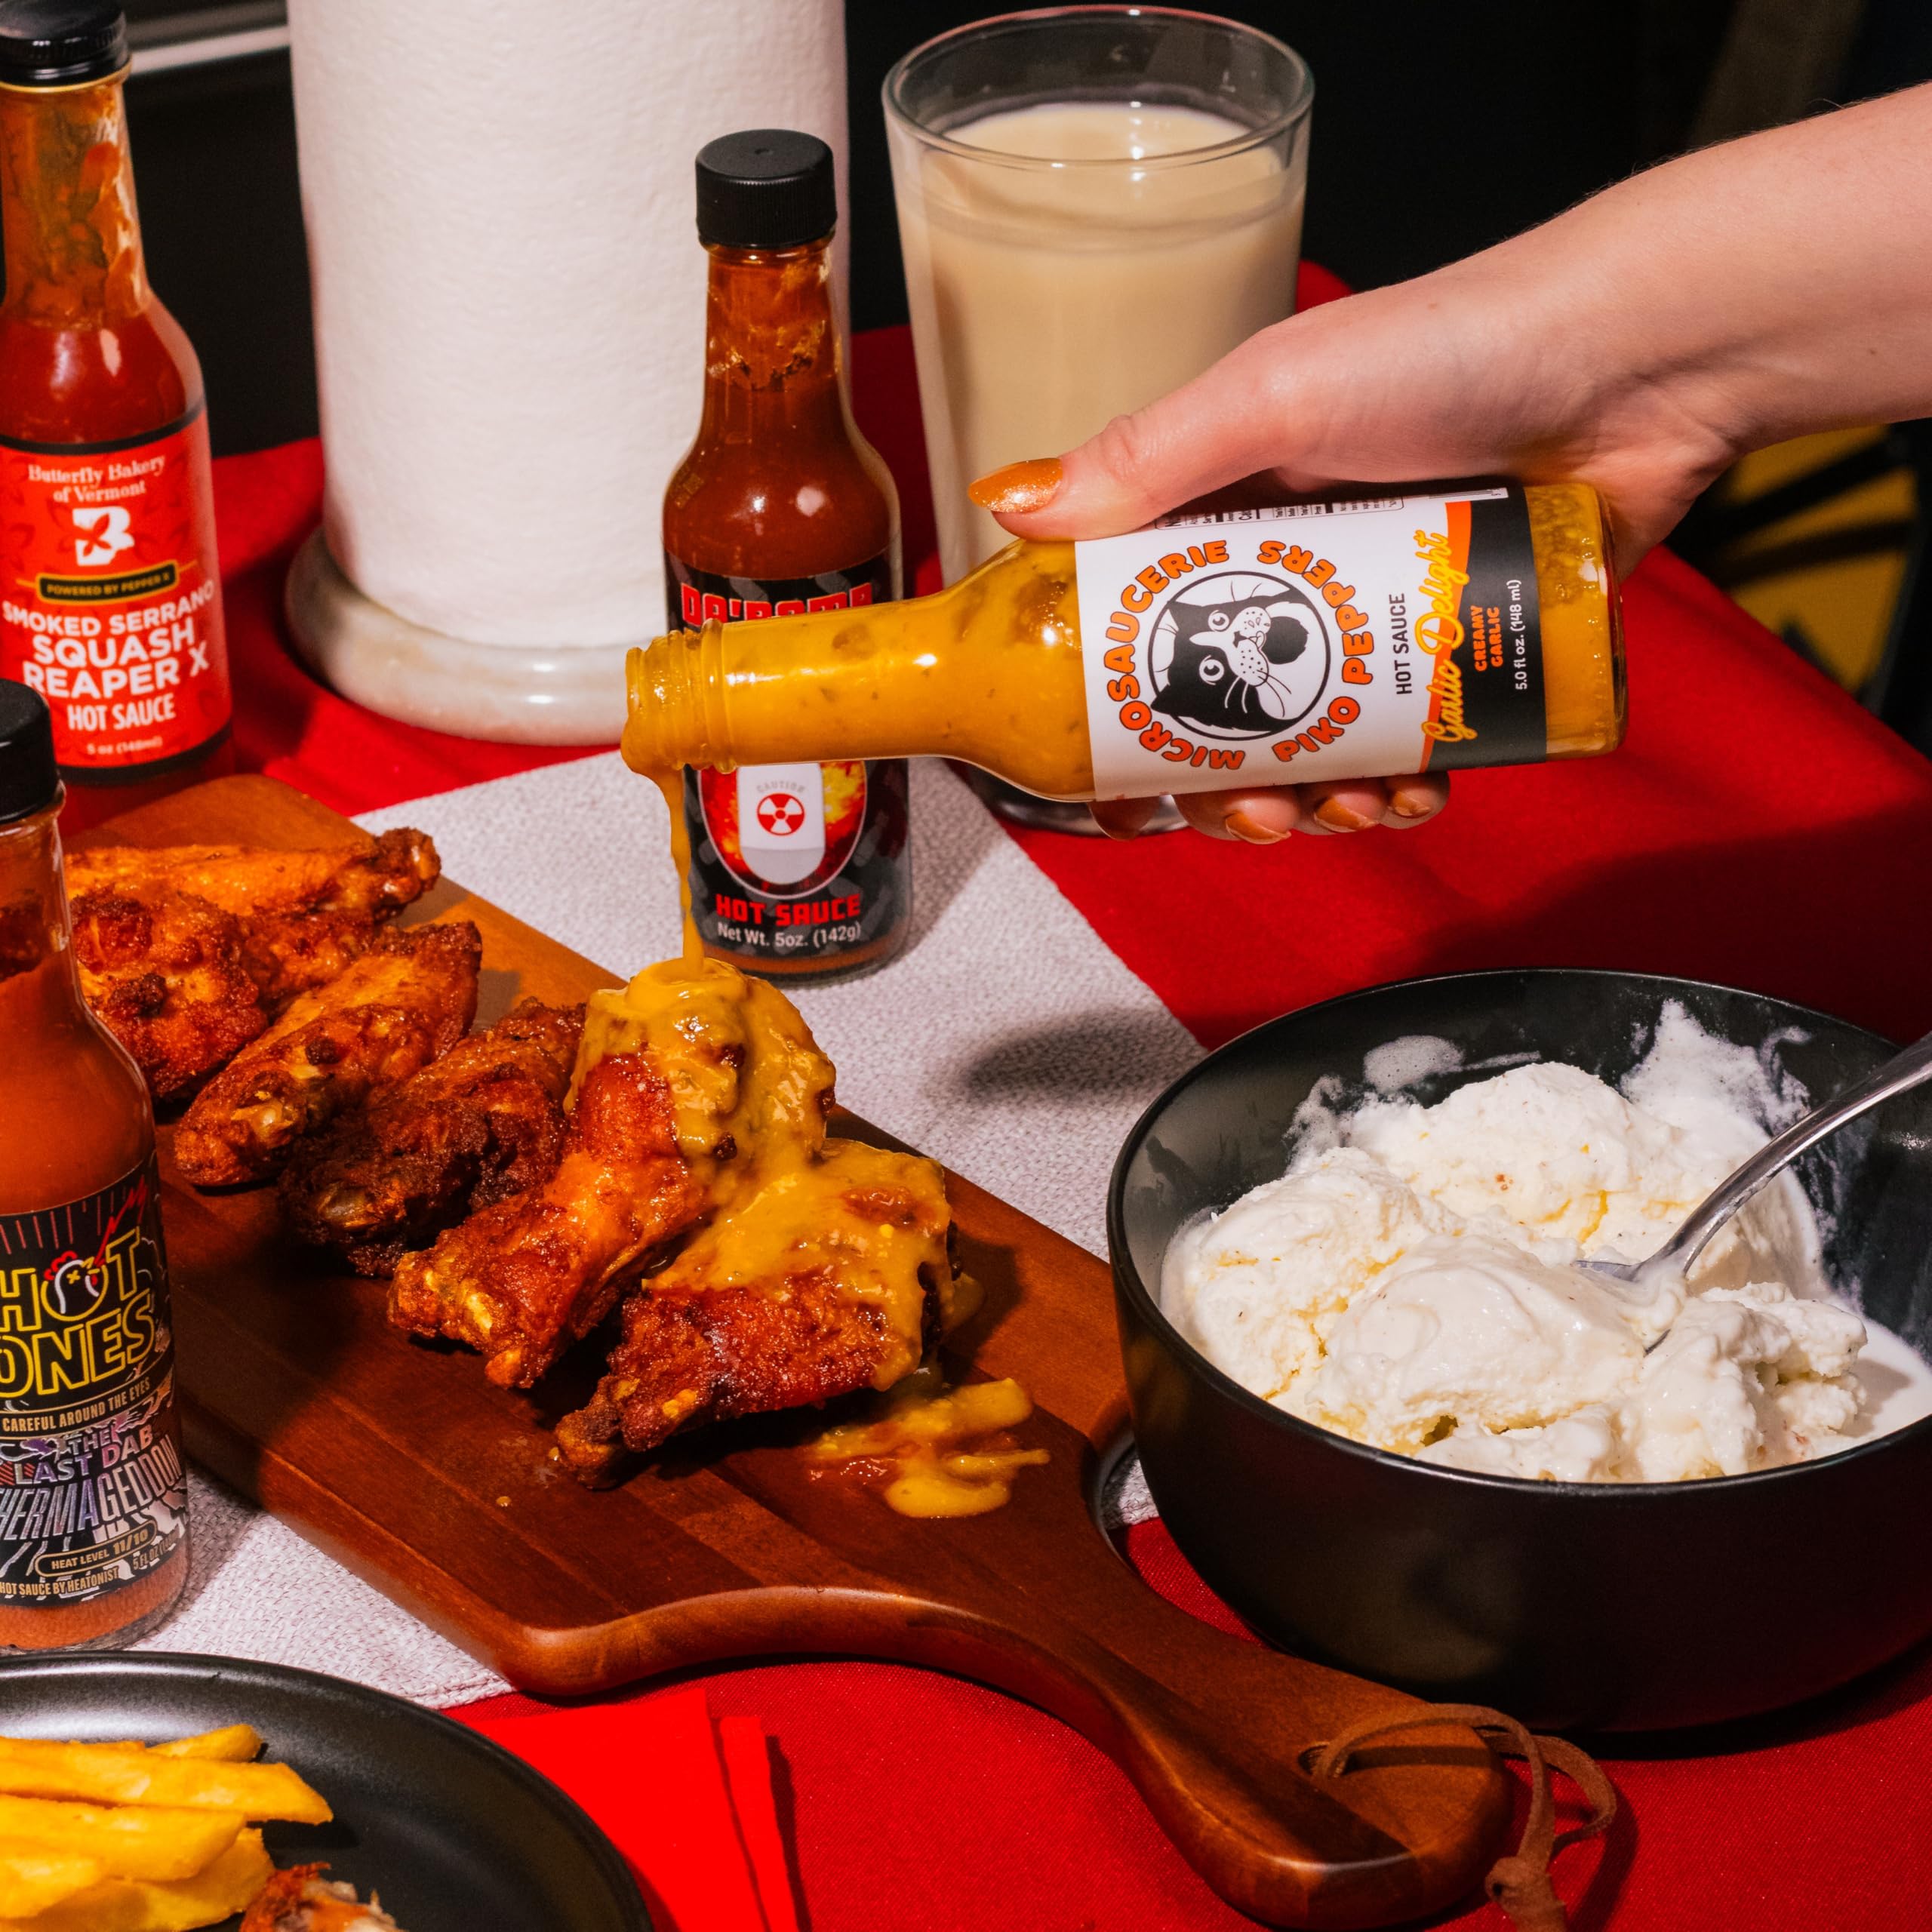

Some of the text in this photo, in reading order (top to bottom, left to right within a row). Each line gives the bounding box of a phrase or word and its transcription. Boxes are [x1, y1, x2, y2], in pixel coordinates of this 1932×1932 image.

[28, 455, 165, 488] Butterfly Bakery
[53, 479, 146, 503] of Vermont
[2, 580, 214, 636] SMOKED SERRANO
[104, 584, 118, 594] BY
[1413, 529, 1470, 655] Delight
[32, 615, 195, 668] SQUASH
[1257, 540, 1374, 762] PIKO PEPPERS
[1389, 593, 1412, 695] HOT SAUCE
[1471, 605, 1487, 672] CREAMY
[1487, 607, 1504, 668] GARLIC
[1506, 579, 1527, 690] 5.0 fl oz. (148 ml)
[23, 640, 209, 699] REAPER X
[67, 692, 176, 731] HOT SAUCE
[715, 893, 860, 927] HOT SAUCE
[718, 920, 861, 948] Net Wt. 5oz. (142g)
[0, 1226, 140, 1333] HOT
[2, 1377, 150, 1432] CAREFUL AROUND THE EYES
[14, 1424, 153, 1485] LAST DAB
[69, 1429, 111, 1456] THE
[0, 1434, 182, 1540] HERMAGEDDON
[51, 1557, 78, 1569] HEAT
[80, 1550, 109, 1564] LEVEL
[114, 1528, 149, 1555] 11/10
[0, 1567, 119, 1595] HOT SAUCE BY HEATONIST
